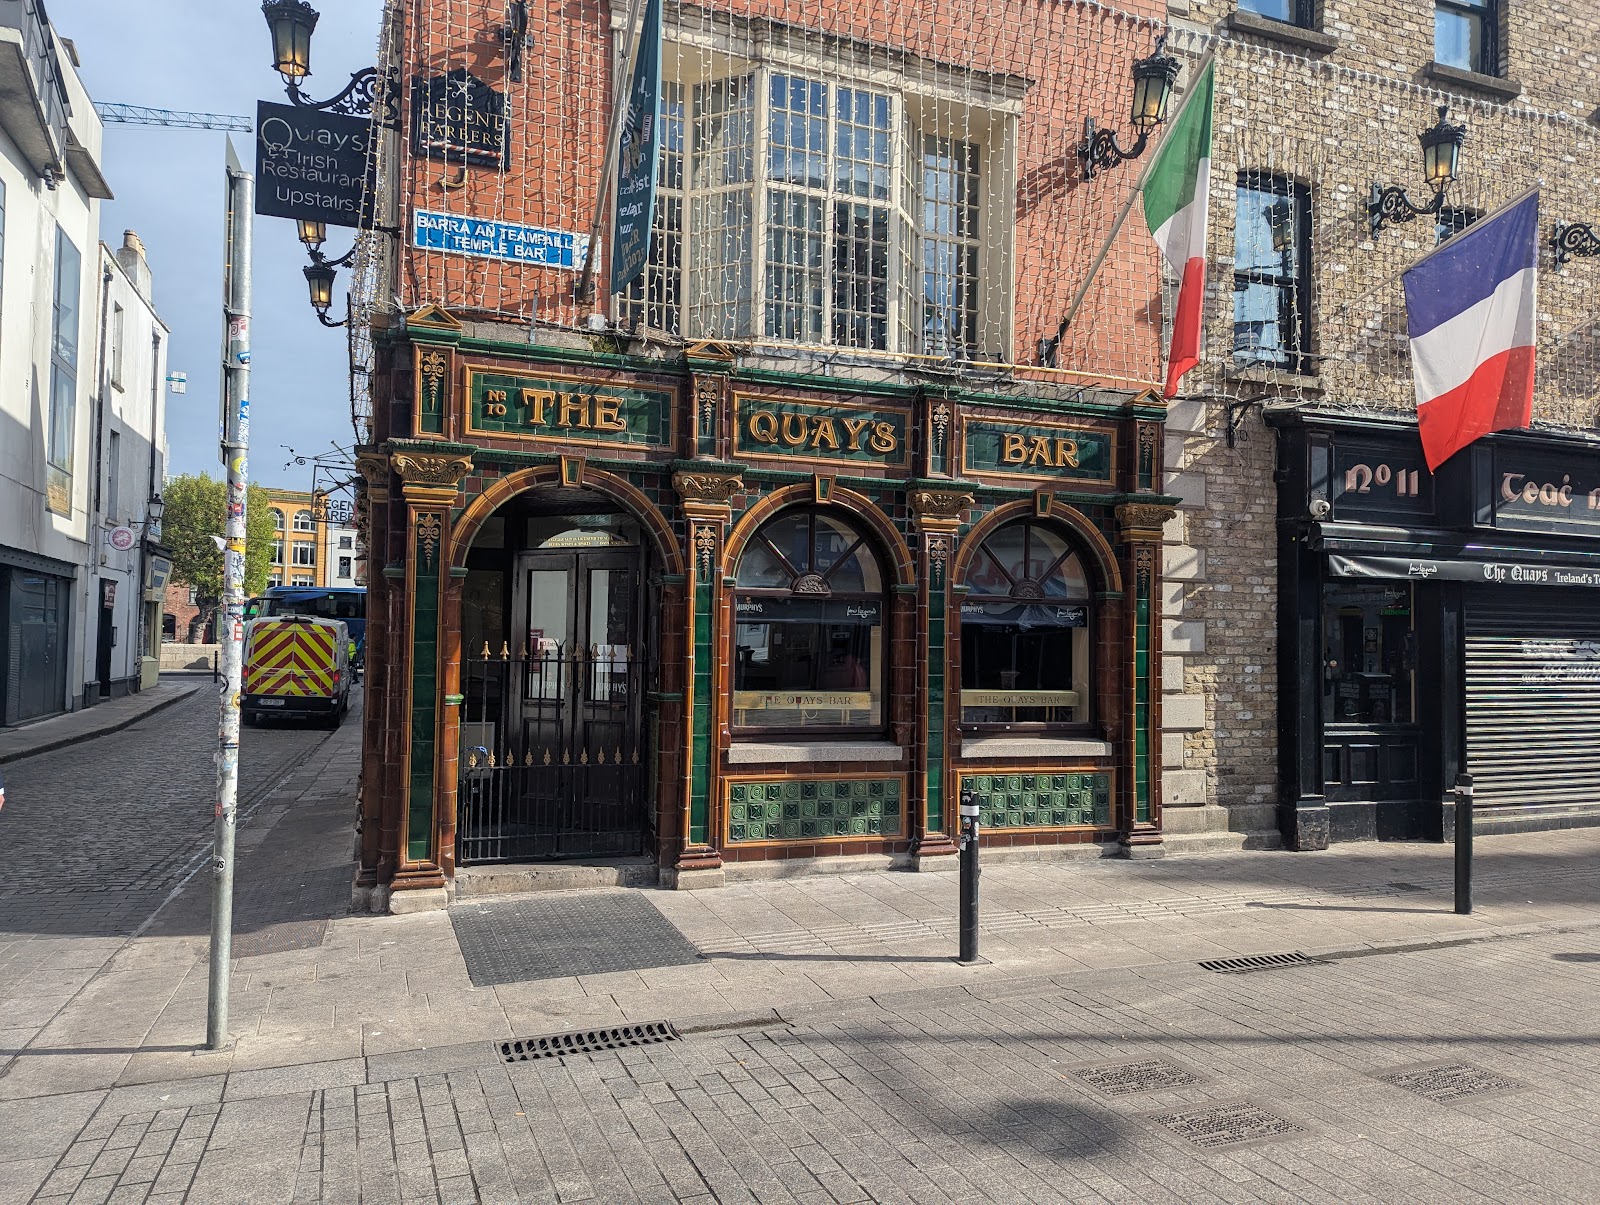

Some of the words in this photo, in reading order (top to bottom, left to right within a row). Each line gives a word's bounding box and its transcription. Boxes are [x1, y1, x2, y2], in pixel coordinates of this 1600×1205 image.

[420, 102, 504, 130] REGENT
[261, 117, 364, 152] Quays
[421, 122, 503, 146] BARBERS
[297, 152, 338, 170] Irish
[276, 186, 354, 212] Upstairs
[417, 215, 470, 234] BARRA
[475, 225, 495, 237] AN
[500, 229, 574, 249] TEAMPAILL
[454, 236, 508, 255] TEMPLE
[514, 245, 546, 261] BAR
[488, 403, 507, 416] 10
[522, 388, 627, 432] THE
[750, 411, 897, 452] QUAY'S
[1003, 433, 1079, 468] BAR
[315, 499, 354, 511] REGEN
[1483, 564, 1506, 583] The
[1511, 565, 1548, 583] Quays
[829, 696, 851, 705] BAR
[978, 695, 999, 703] THE
[1041, 696, 1060, 704] BAR
